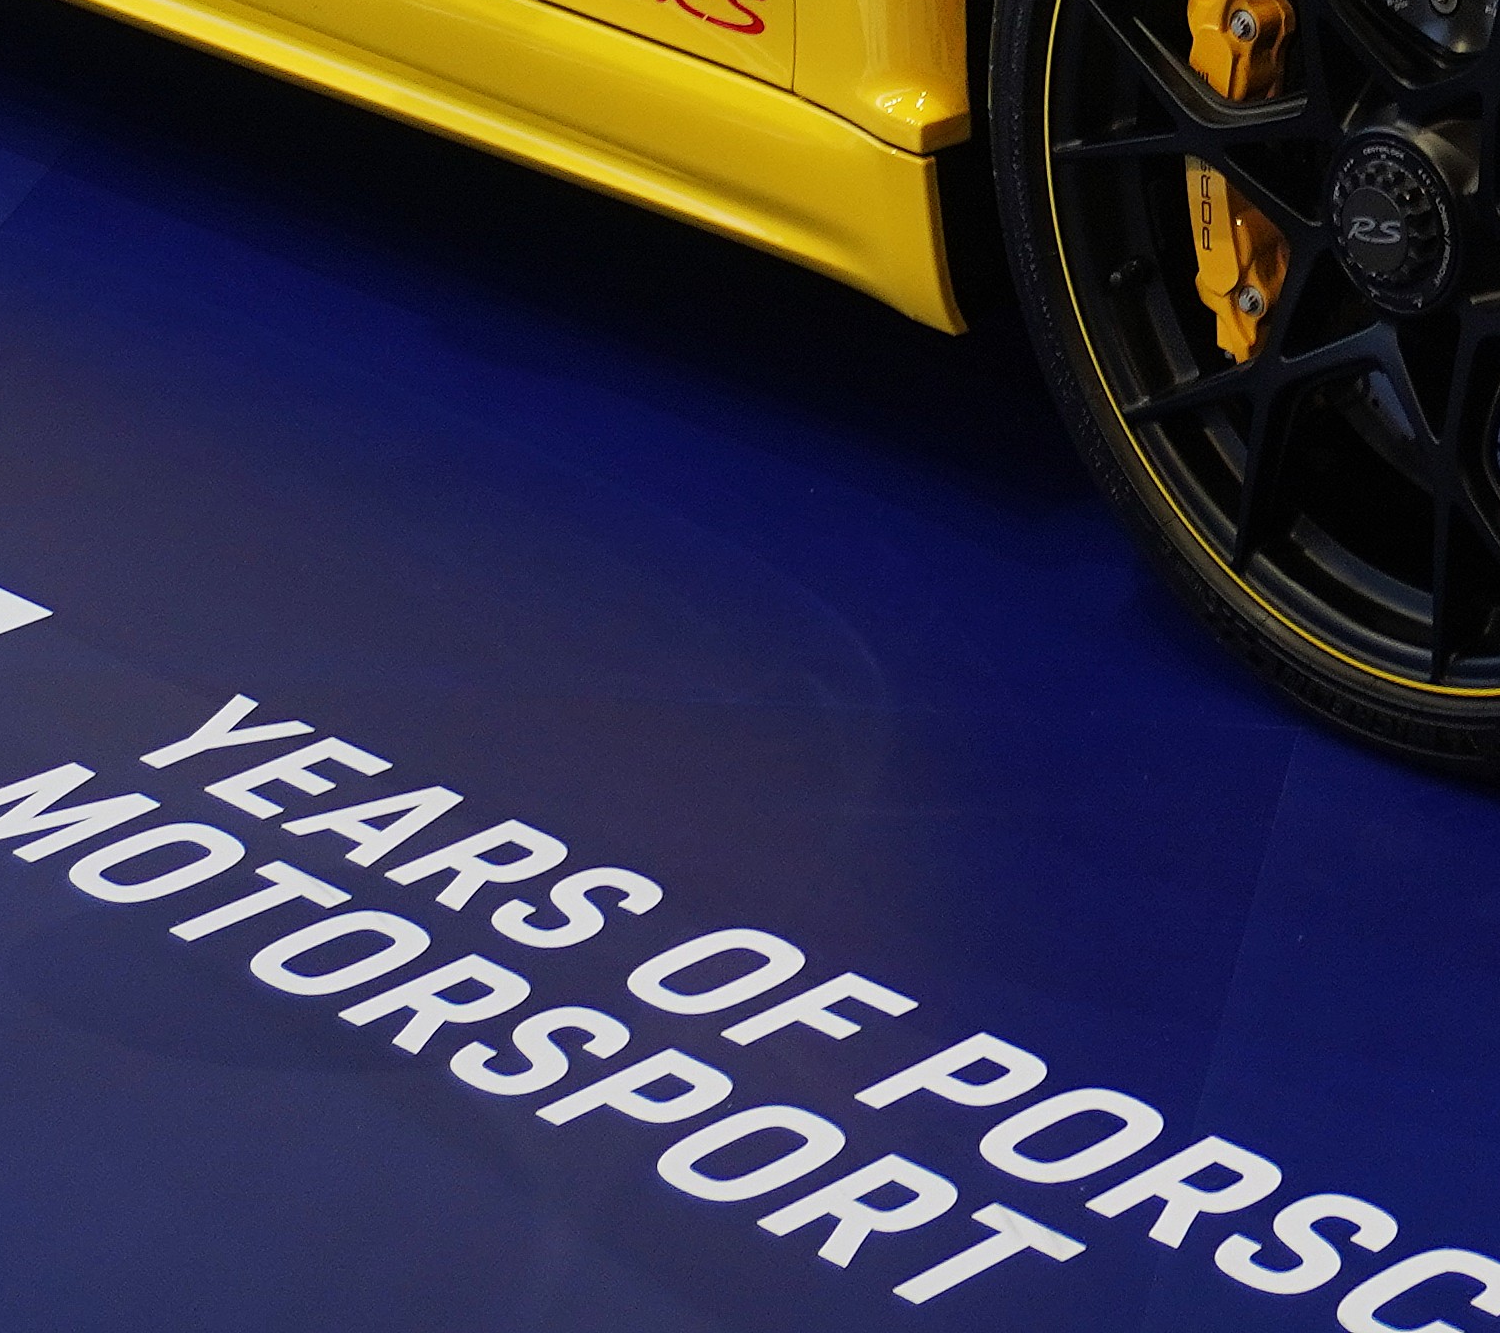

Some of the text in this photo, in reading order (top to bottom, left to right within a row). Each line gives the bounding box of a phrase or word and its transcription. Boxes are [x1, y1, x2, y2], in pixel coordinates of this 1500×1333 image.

[1347, 216, 1402, 245] RS
[140, 694, 663, 948] YEARS
[627, 929, 918, 1046] OF
